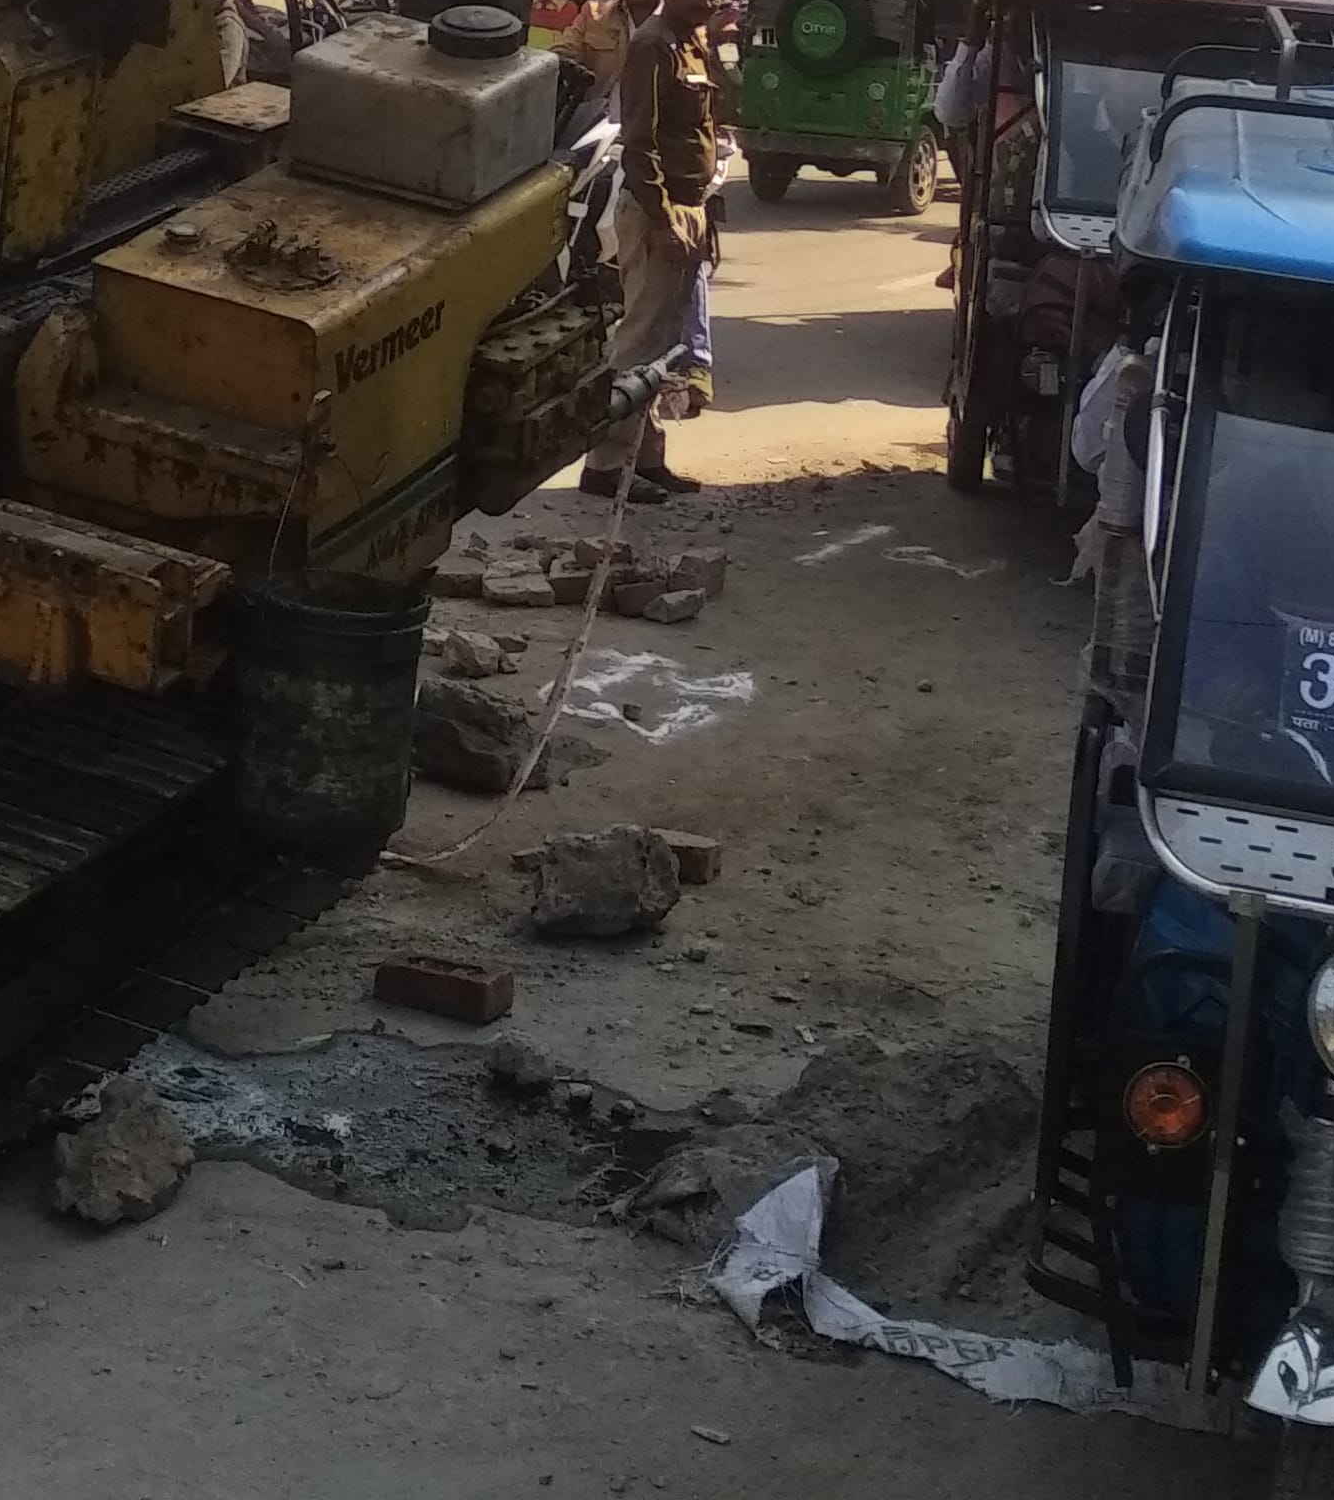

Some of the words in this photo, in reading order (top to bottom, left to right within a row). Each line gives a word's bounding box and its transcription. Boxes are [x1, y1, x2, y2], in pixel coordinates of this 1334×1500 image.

[333, 299, 446, 395] Vermeer
[1298, 626, 1326, 649] (M)
[1291, 715, 1320, 731] पता
